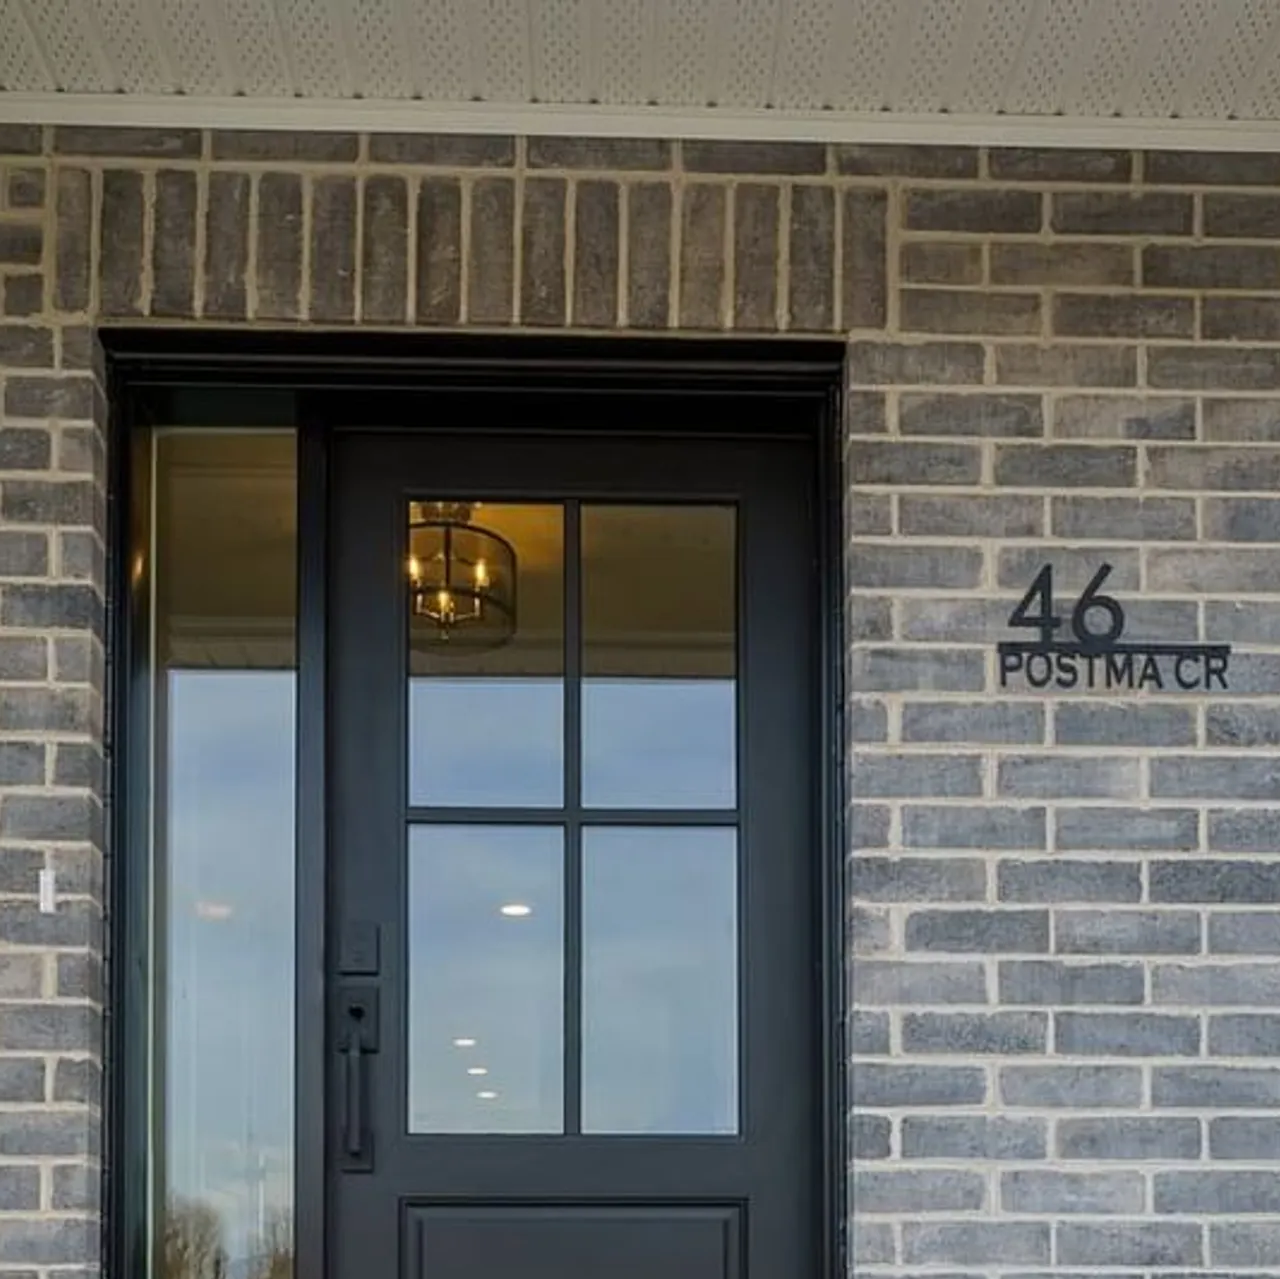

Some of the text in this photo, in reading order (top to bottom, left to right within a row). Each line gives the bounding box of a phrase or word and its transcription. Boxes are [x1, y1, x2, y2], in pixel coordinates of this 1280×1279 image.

[1007, 562, 1126, 648] 46
[998, 650, 1230, 690] POSTMA CR
